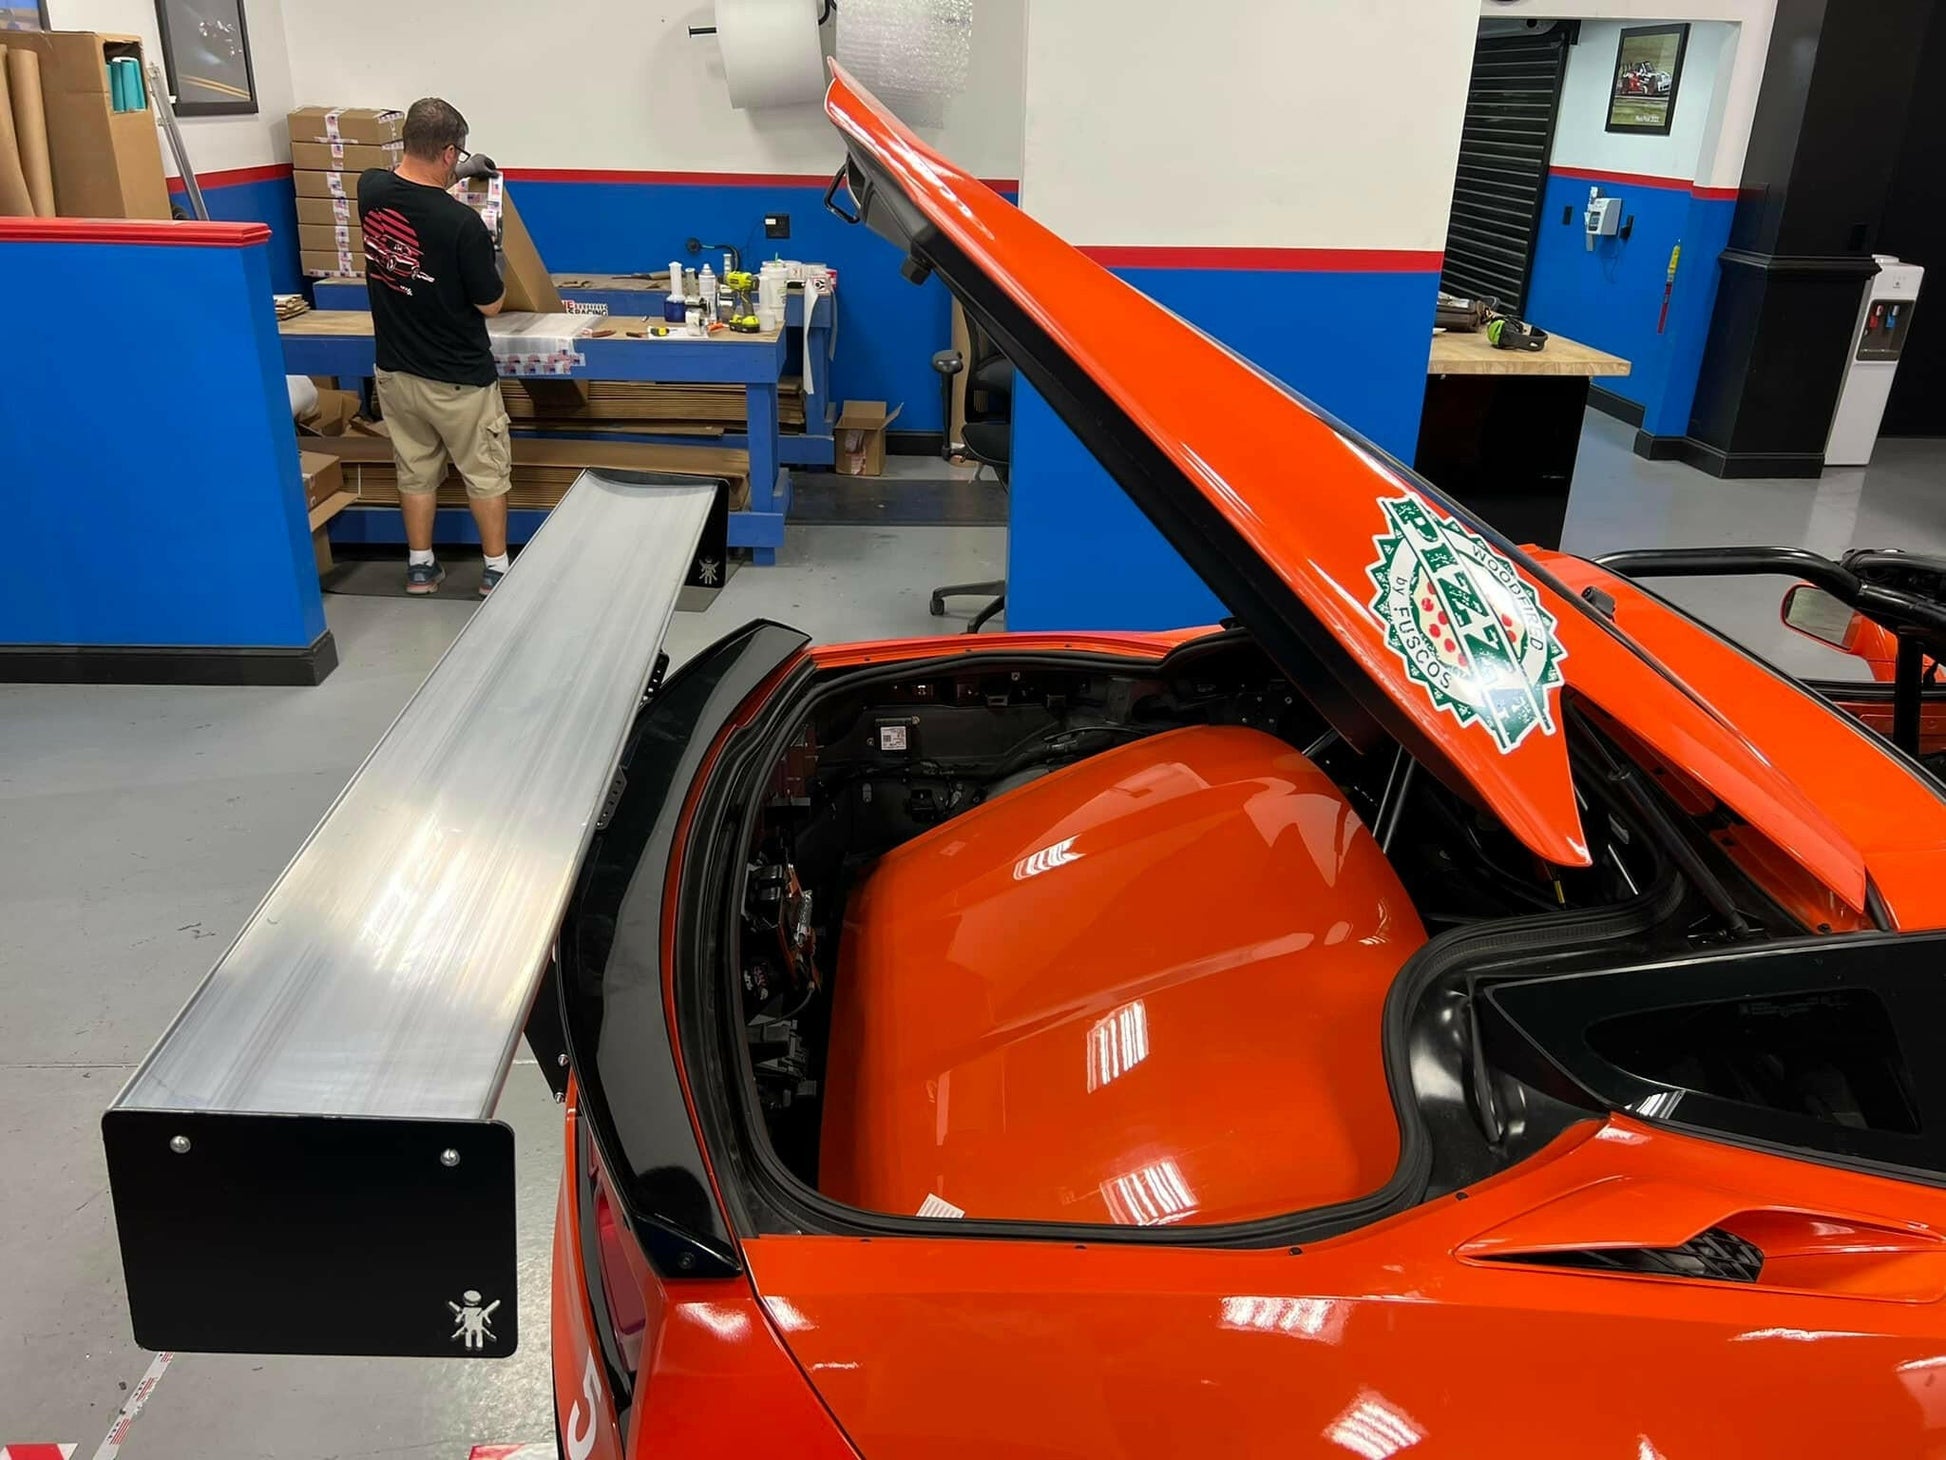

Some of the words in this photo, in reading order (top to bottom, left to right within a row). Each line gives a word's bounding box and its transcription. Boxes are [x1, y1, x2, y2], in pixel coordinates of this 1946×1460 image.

[1393, 576, 1408, 596] by
[1472, 544, 1544, 652] WOODFIRED
[1393, 607, 1453, 690] FUSCOS
